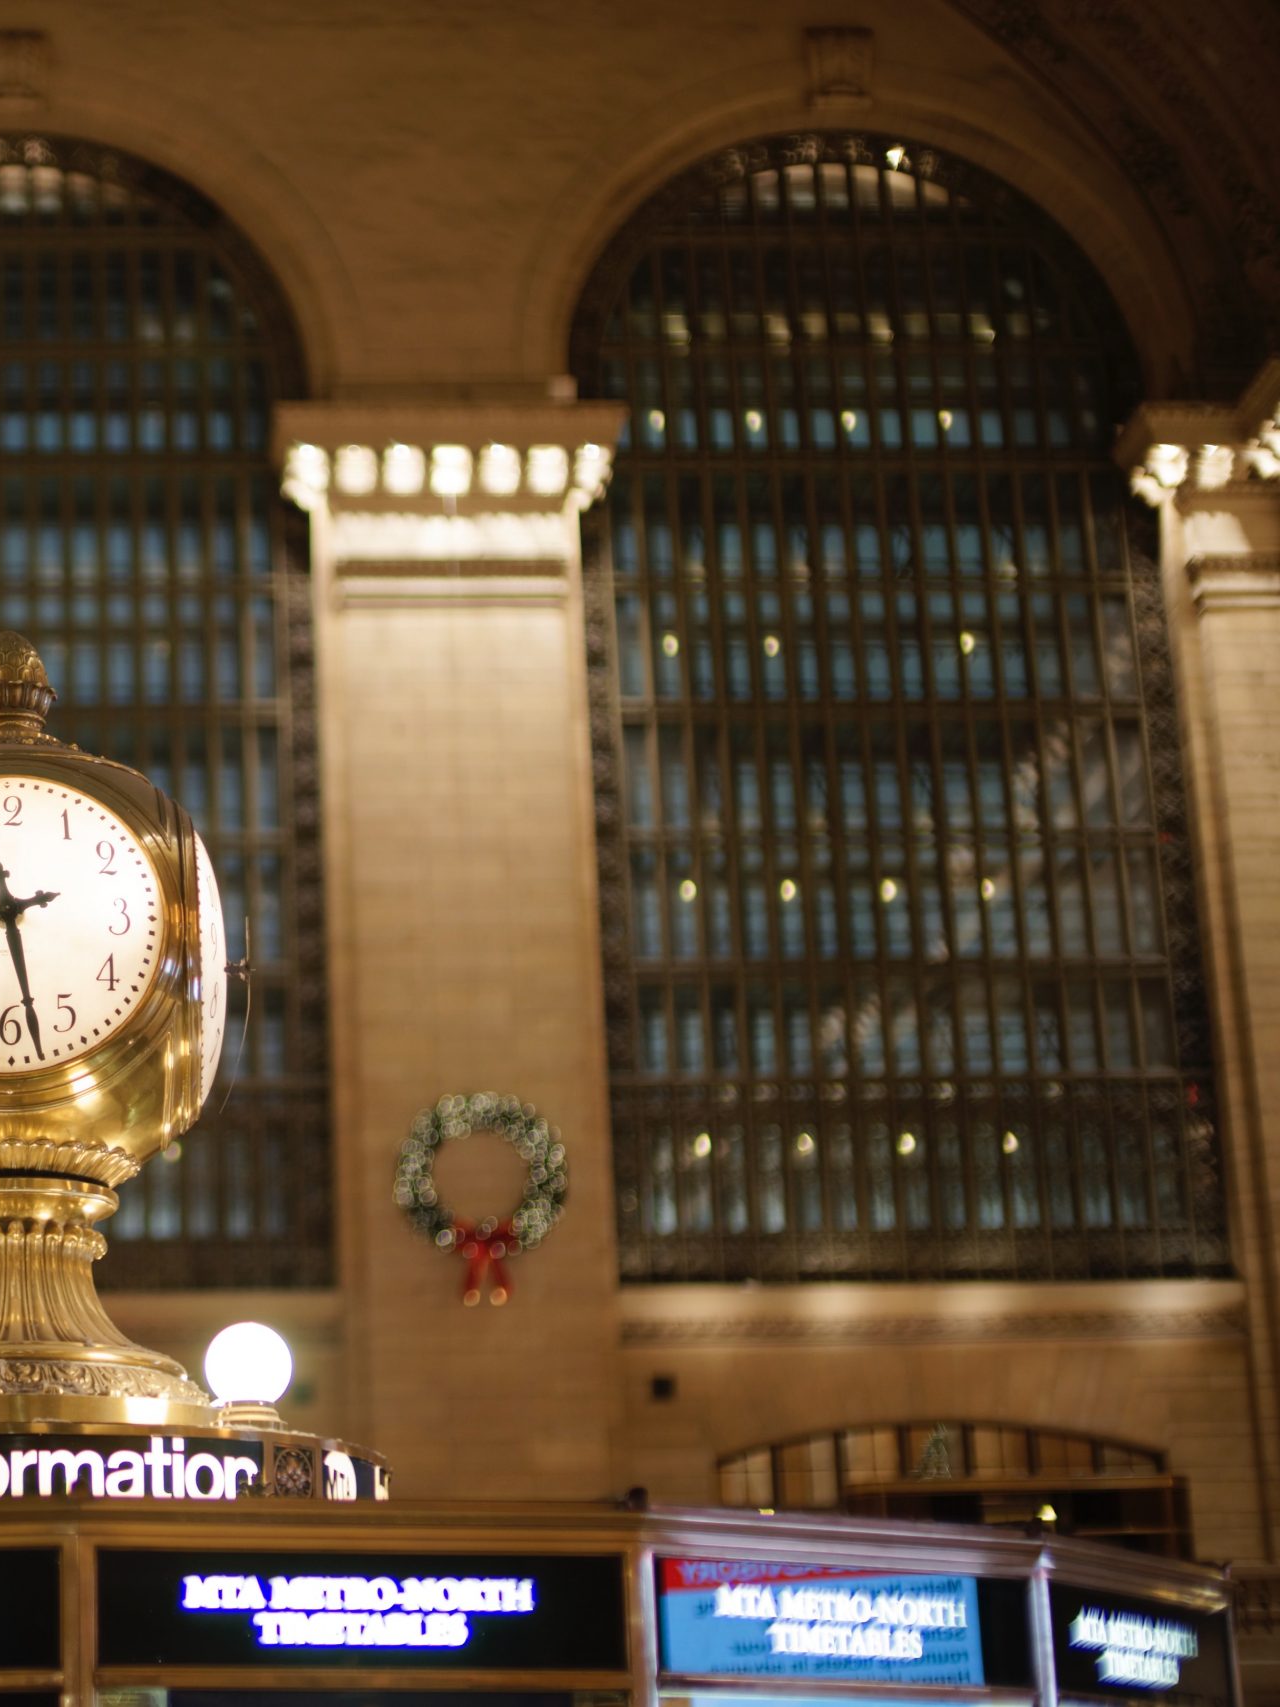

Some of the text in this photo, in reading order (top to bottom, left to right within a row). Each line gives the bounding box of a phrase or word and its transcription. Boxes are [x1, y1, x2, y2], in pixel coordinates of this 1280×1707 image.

[60, 808, 73, 840] 1
[95, 840, 118, 876] 2
[108, 897, 131, 936] 3
[95, 952, 121, 991] 4
[53, 993, 77, 1033] 5
[183, 1575, 535, 1612] MTA METRO-NORTH
[713, 1582, 777, 1620] MTA
[776, 1585, 968, 1628] METRO-NORTH
[253, 1612, 469, 1646] TIMETABLES
[766, 1621, 924, 1660] TIMETABLES
